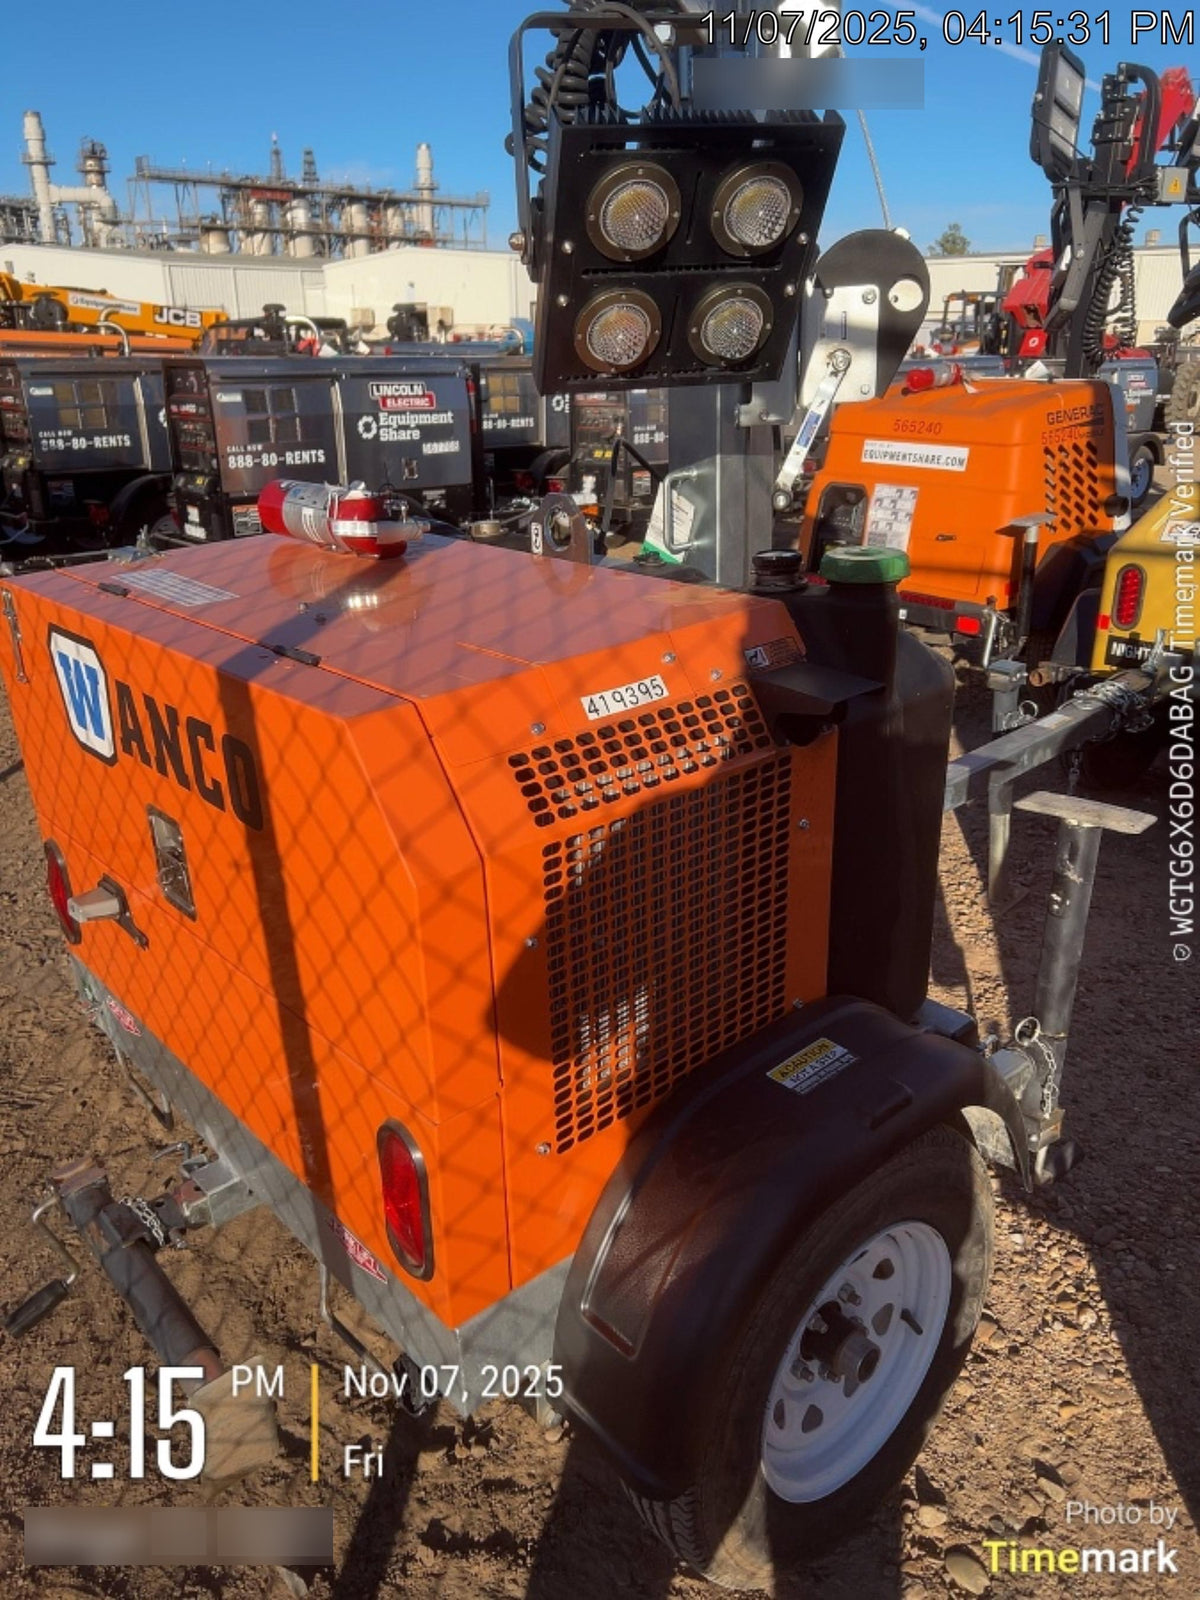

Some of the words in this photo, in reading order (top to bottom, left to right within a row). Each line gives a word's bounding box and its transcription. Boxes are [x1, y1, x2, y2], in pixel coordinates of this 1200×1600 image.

[154, 308, 202, 328] JCB
[372, 384, 424, 396] LINCOLN
[386, 397, 430, 408] ELECTRIC
[378, 410, 454, 428] Equipment
[893, 418, 943, 436] 565240
[40, 434, 131, 452] 888-80-RENTS
[379, 427, 421, 442] Share
[228, 449, 326, 470] 888-80-RENTS
[863, 448, 966, 467] EQUIPMENTSHARE.COM
[586, 677, 665, 717] 419395
[56, 649, 264, 832] WANCO
